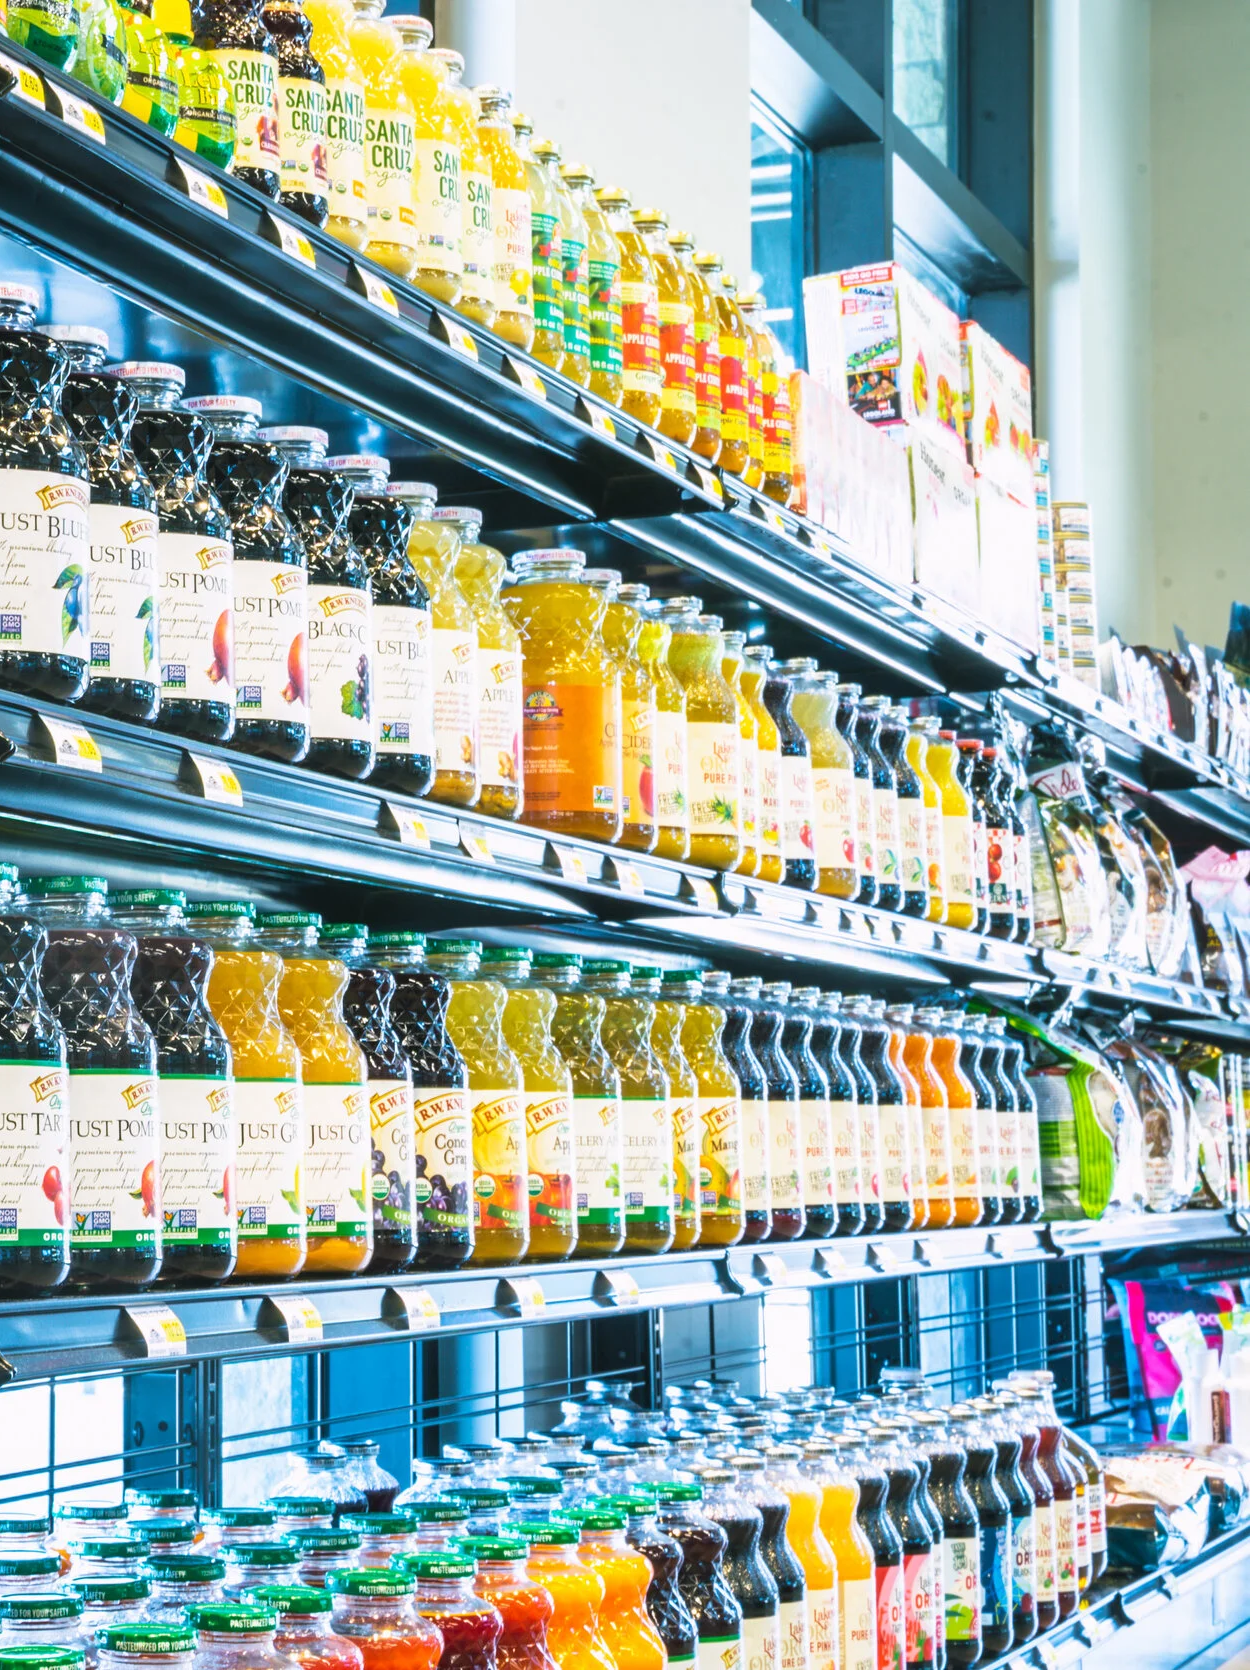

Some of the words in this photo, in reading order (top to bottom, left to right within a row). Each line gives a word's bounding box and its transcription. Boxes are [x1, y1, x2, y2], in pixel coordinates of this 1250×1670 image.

[228, 60, 275, 89] SANTA
[234, 84, 273, 108] CRUZ
[286, 88, 326, 112] SANTA
[326, 88, 364, 118] SANTA
[292, 111, 325, 134] CRUZ
[327, 115, 364, 146] CRUZ
[365, 118, 412, 148] SANTA
[372, 145, 412, 174] CRUZ
[440, 176, 460, 203] CRU
[473, 205, 492, 231] CRU
[90, 545, 127, 565] UST
[159, 572, 193, 588] UST
[234, 597, 270, 613] UST
[1, 614, 20, 622] NON
[308, 621, 354, 641] BLACK
[376, 640, 404, 655] UST
[703, 772, 725, 784] PURE
[164, 1122, 199, 1140] UST
[238, 1122, 278, 1148] JUST
[308, 1124, 346, 1149] JUST
[575, 1135, 603, 1147] ELERY
[711, 1139, 738, 1154] Mang
[437, 1213, 467, 1226] ORGA
[359, 1584, 399, 1594] PASTEURIZED
[49, 1607, 69, 1617] SAFETY
[851, 1630, 868, 1641] PURE
[116, 1640, 156, 1652] PASTEURIZED
[157, 1641, 170, 1652] FOR
[170, 1640, 184, 1651] YOUR
[782, 1658, 795, 1668] URE
